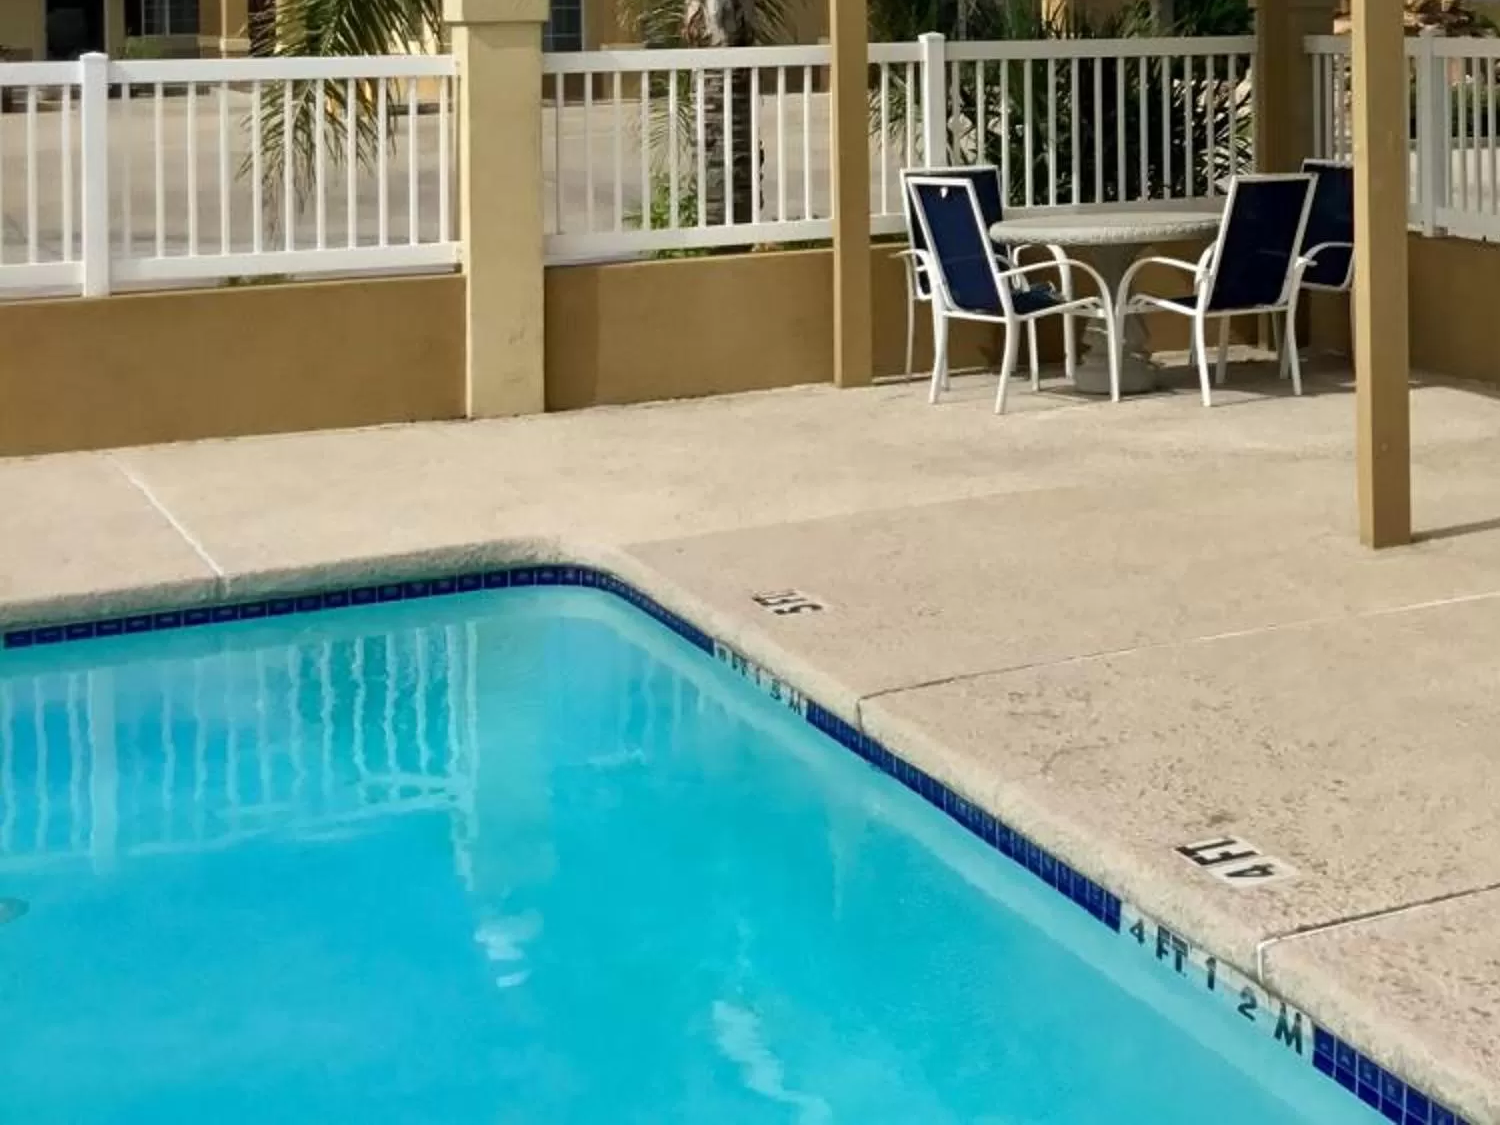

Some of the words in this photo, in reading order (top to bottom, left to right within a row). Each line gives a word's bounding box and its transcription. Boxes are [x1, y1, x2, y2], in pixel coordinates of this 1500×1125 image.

[1223, 861, 1275, 878] 4
[1128, 918, 1145, 945] 4
[1274, 1002, 1303, 1056] M
